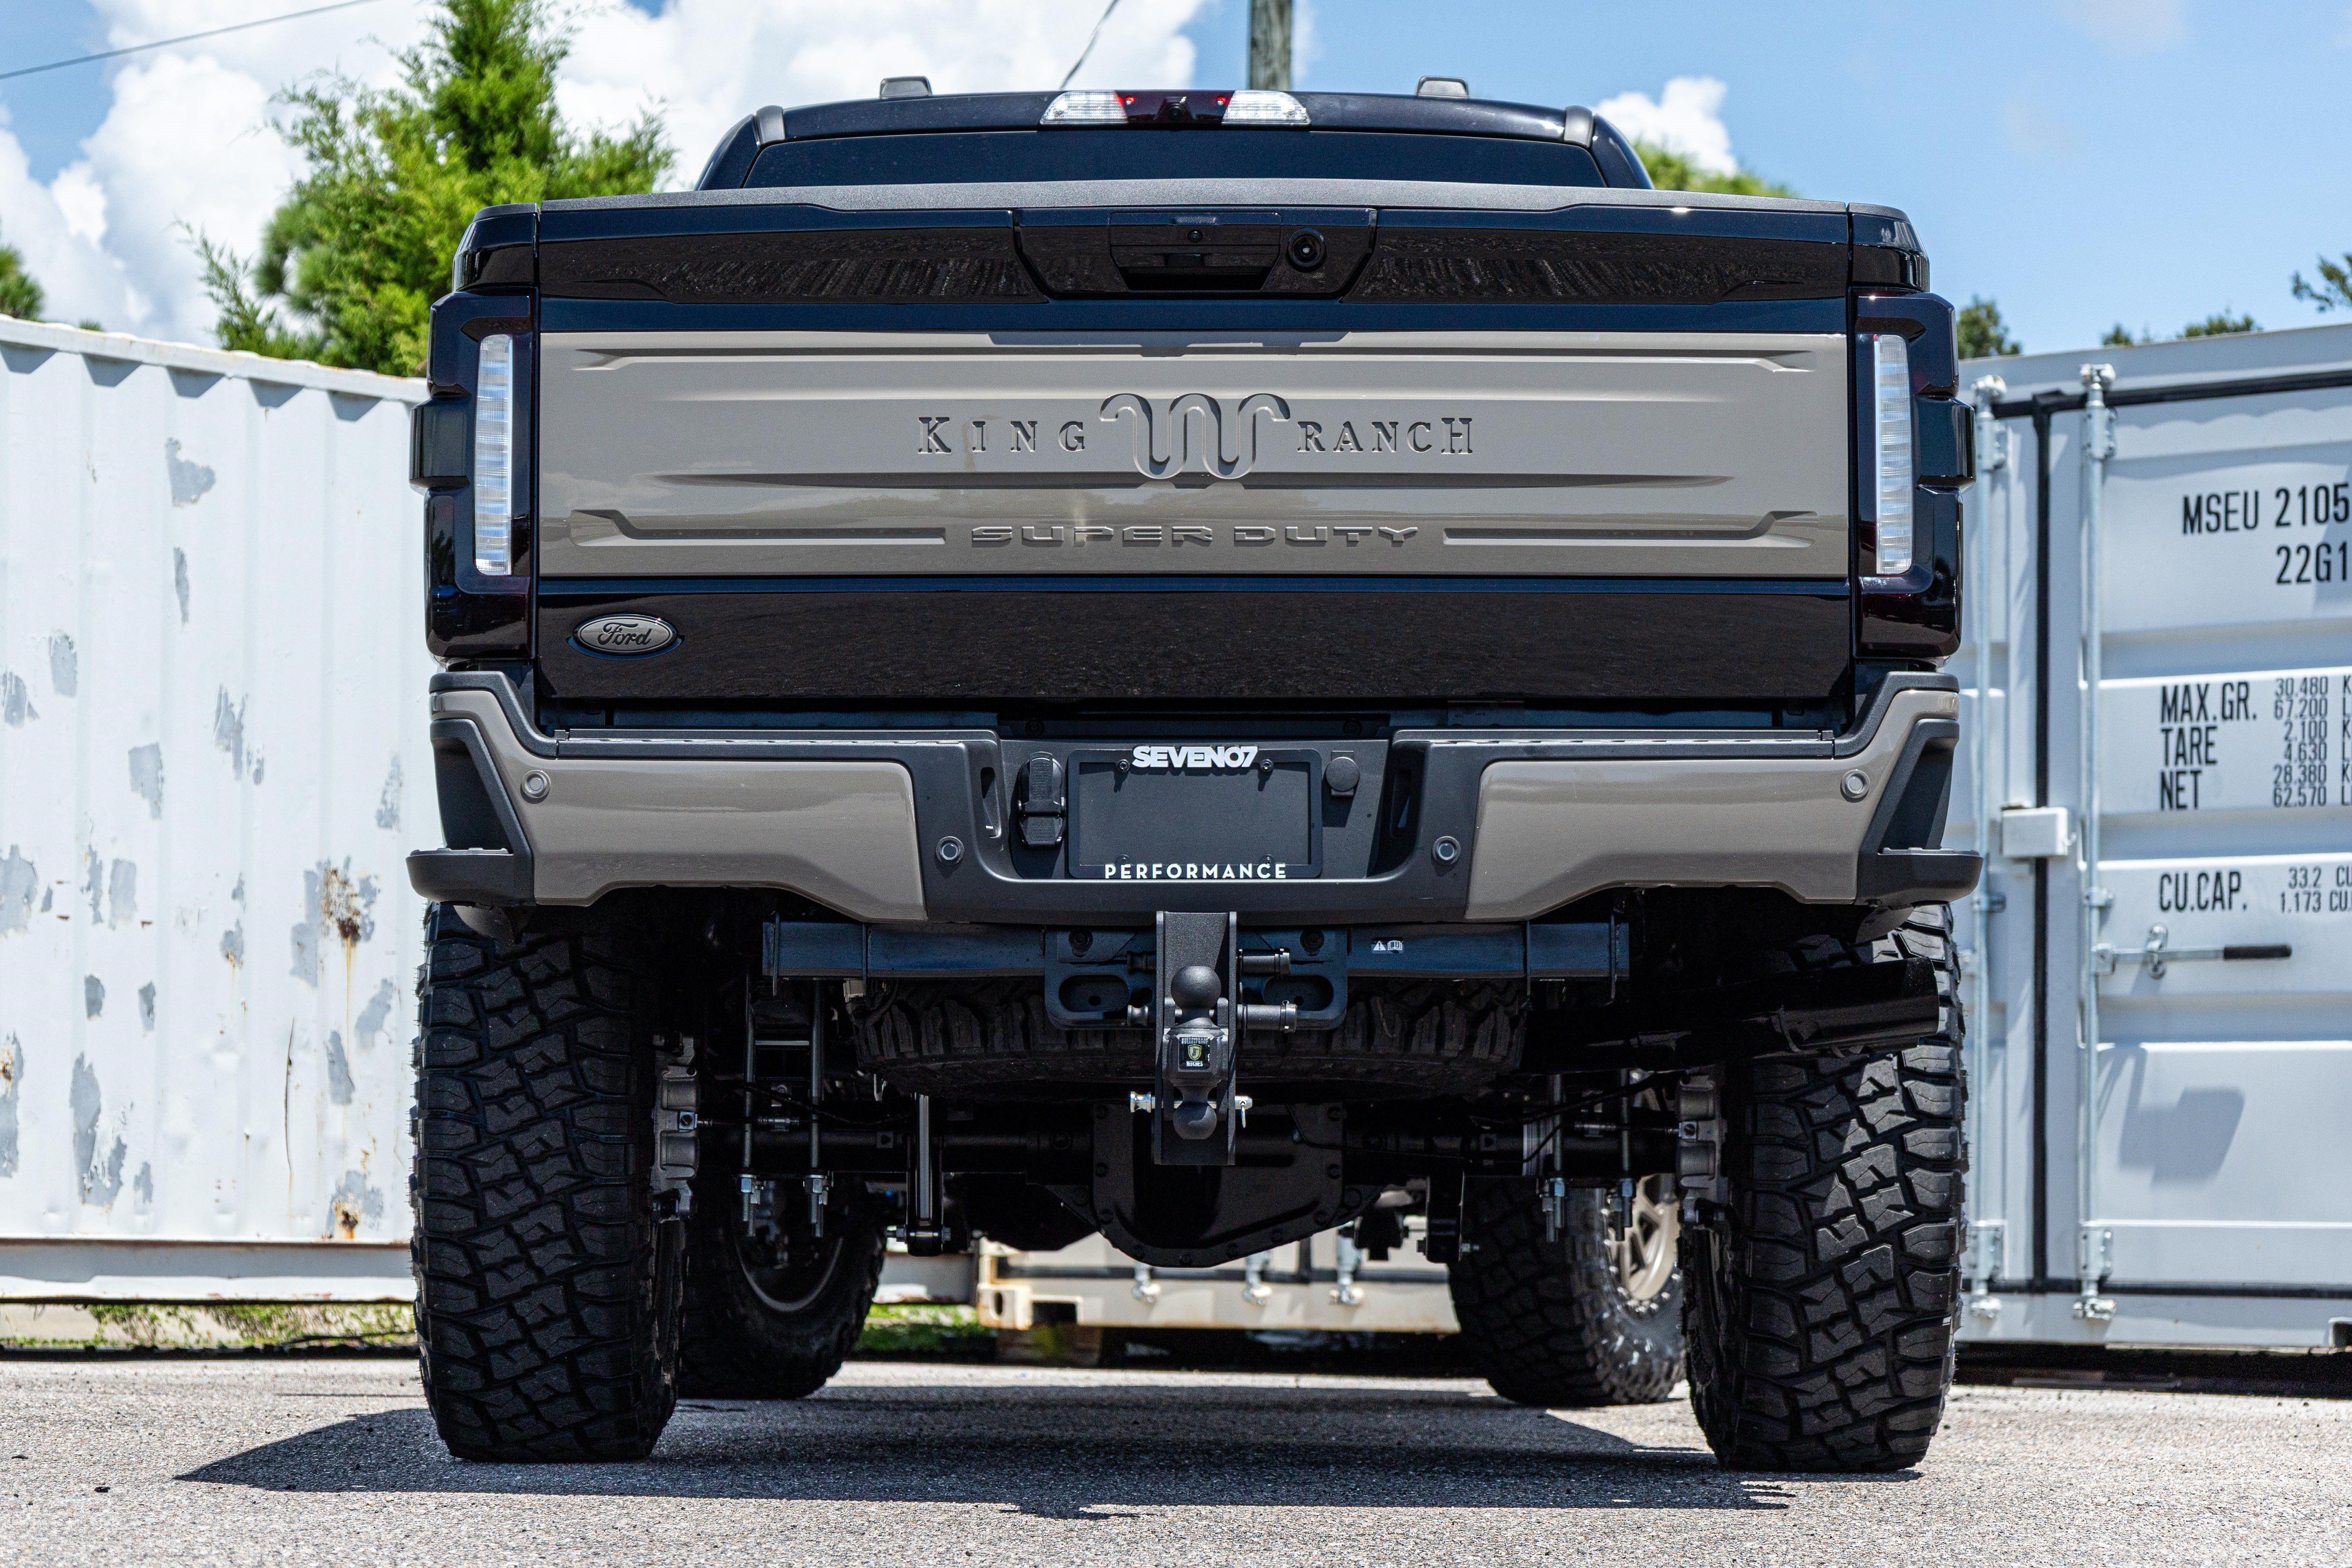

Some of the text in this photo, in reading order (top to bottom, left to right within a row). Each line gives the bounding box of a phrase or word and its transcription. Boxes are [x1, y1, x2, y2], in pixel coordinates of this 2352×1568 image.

[918, 416, 1472, 455] KING RANCH
[2183, 483, 2350, 535] MSEU 2105
[971, 526, 1418, 543] SUPER DUTY
[2276, 541, 2348, 584] 22G1
[597, 622, 651, 645] Ford
[2161, 675, 2352, 723] MAX.GR. 30.480 K
[2274, 697, 2328, 719] 67.200
[2161, 726, 2217, 766] TARE
[2342, 719, 2352, 739] K
[2160, 770, 2202, 811] NET
[2341, 763, 2352, 784] K
[1105, 863, 1287, 880] PERFORMANCE
[2159, 871, 2247, 912] CU.CAP.
[2281, 890, 2321, 914] 1.173
